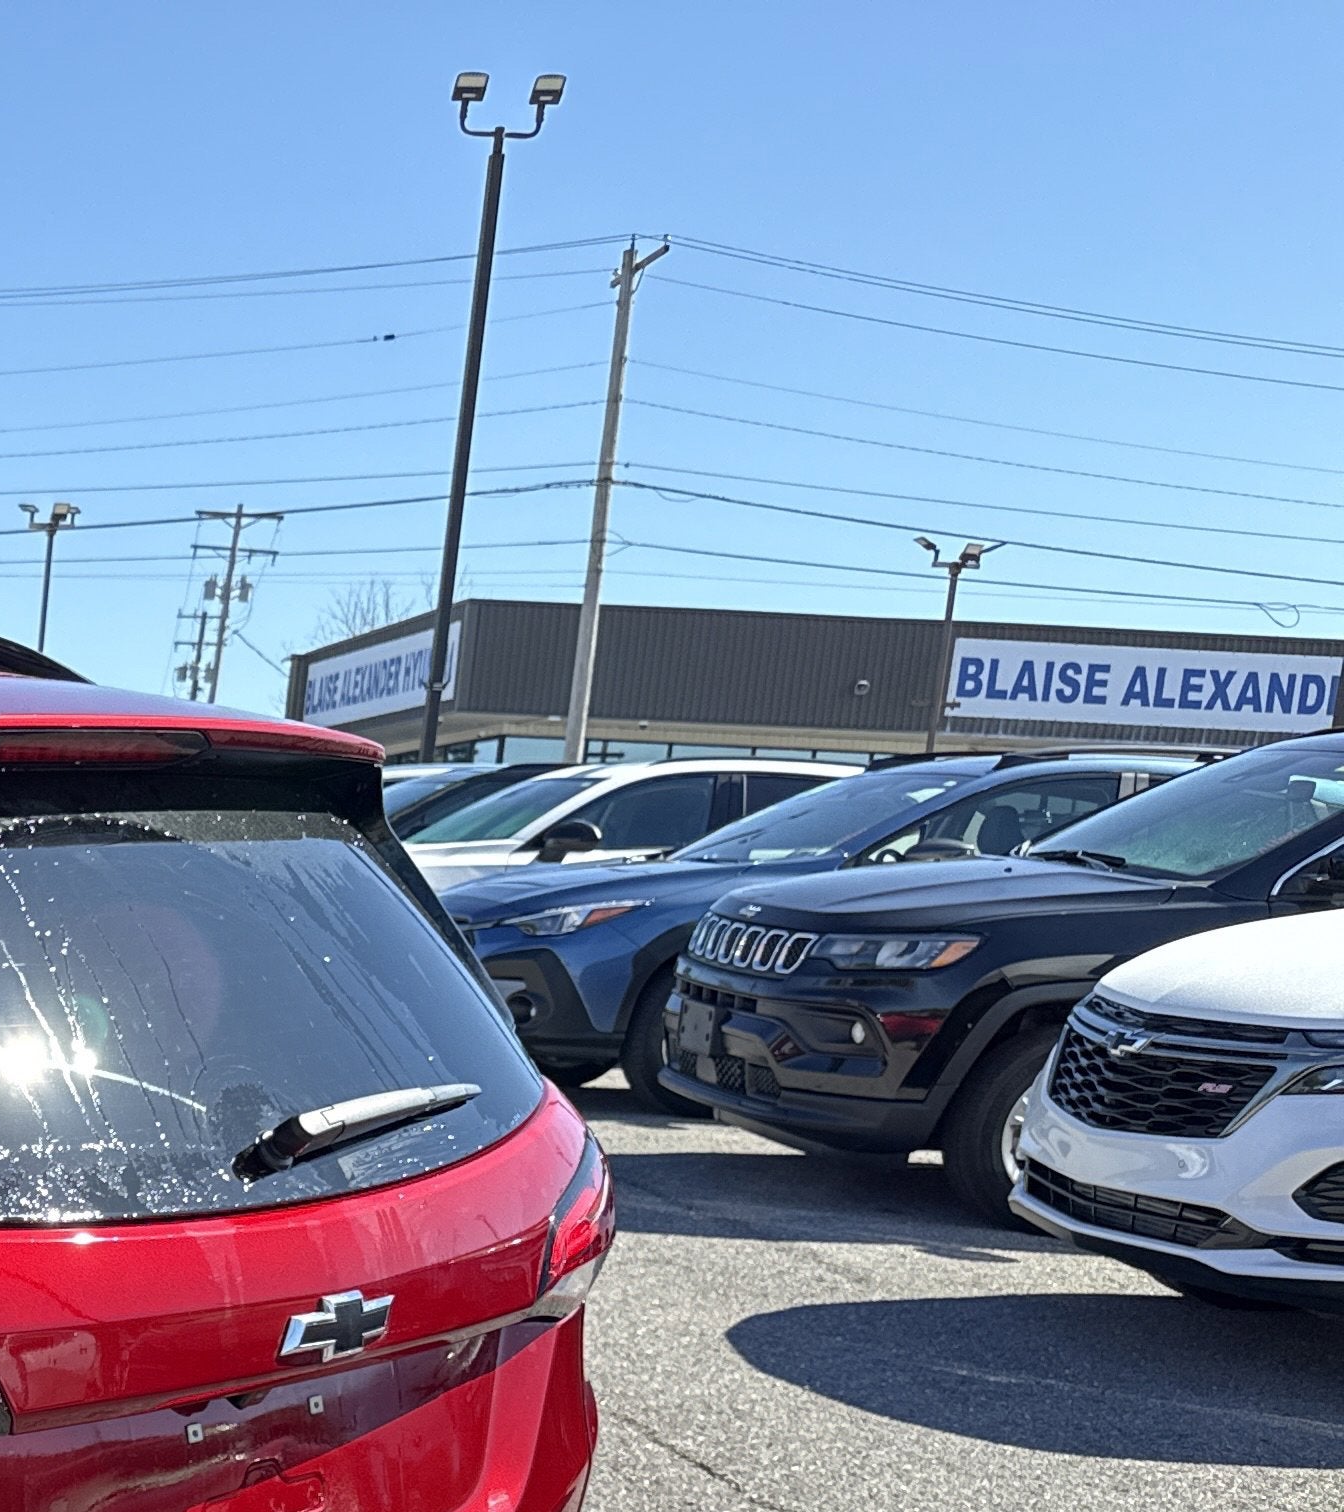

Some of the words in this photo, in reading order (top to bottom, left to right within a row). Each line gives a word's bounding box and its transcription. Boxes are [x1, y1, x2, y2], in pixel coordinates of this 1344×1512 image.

[305, 671, 340, 716] BLAISE
[339, 655, 402, 708] ALEXANDER
[955, 656, 1112, 706] BLAISE
